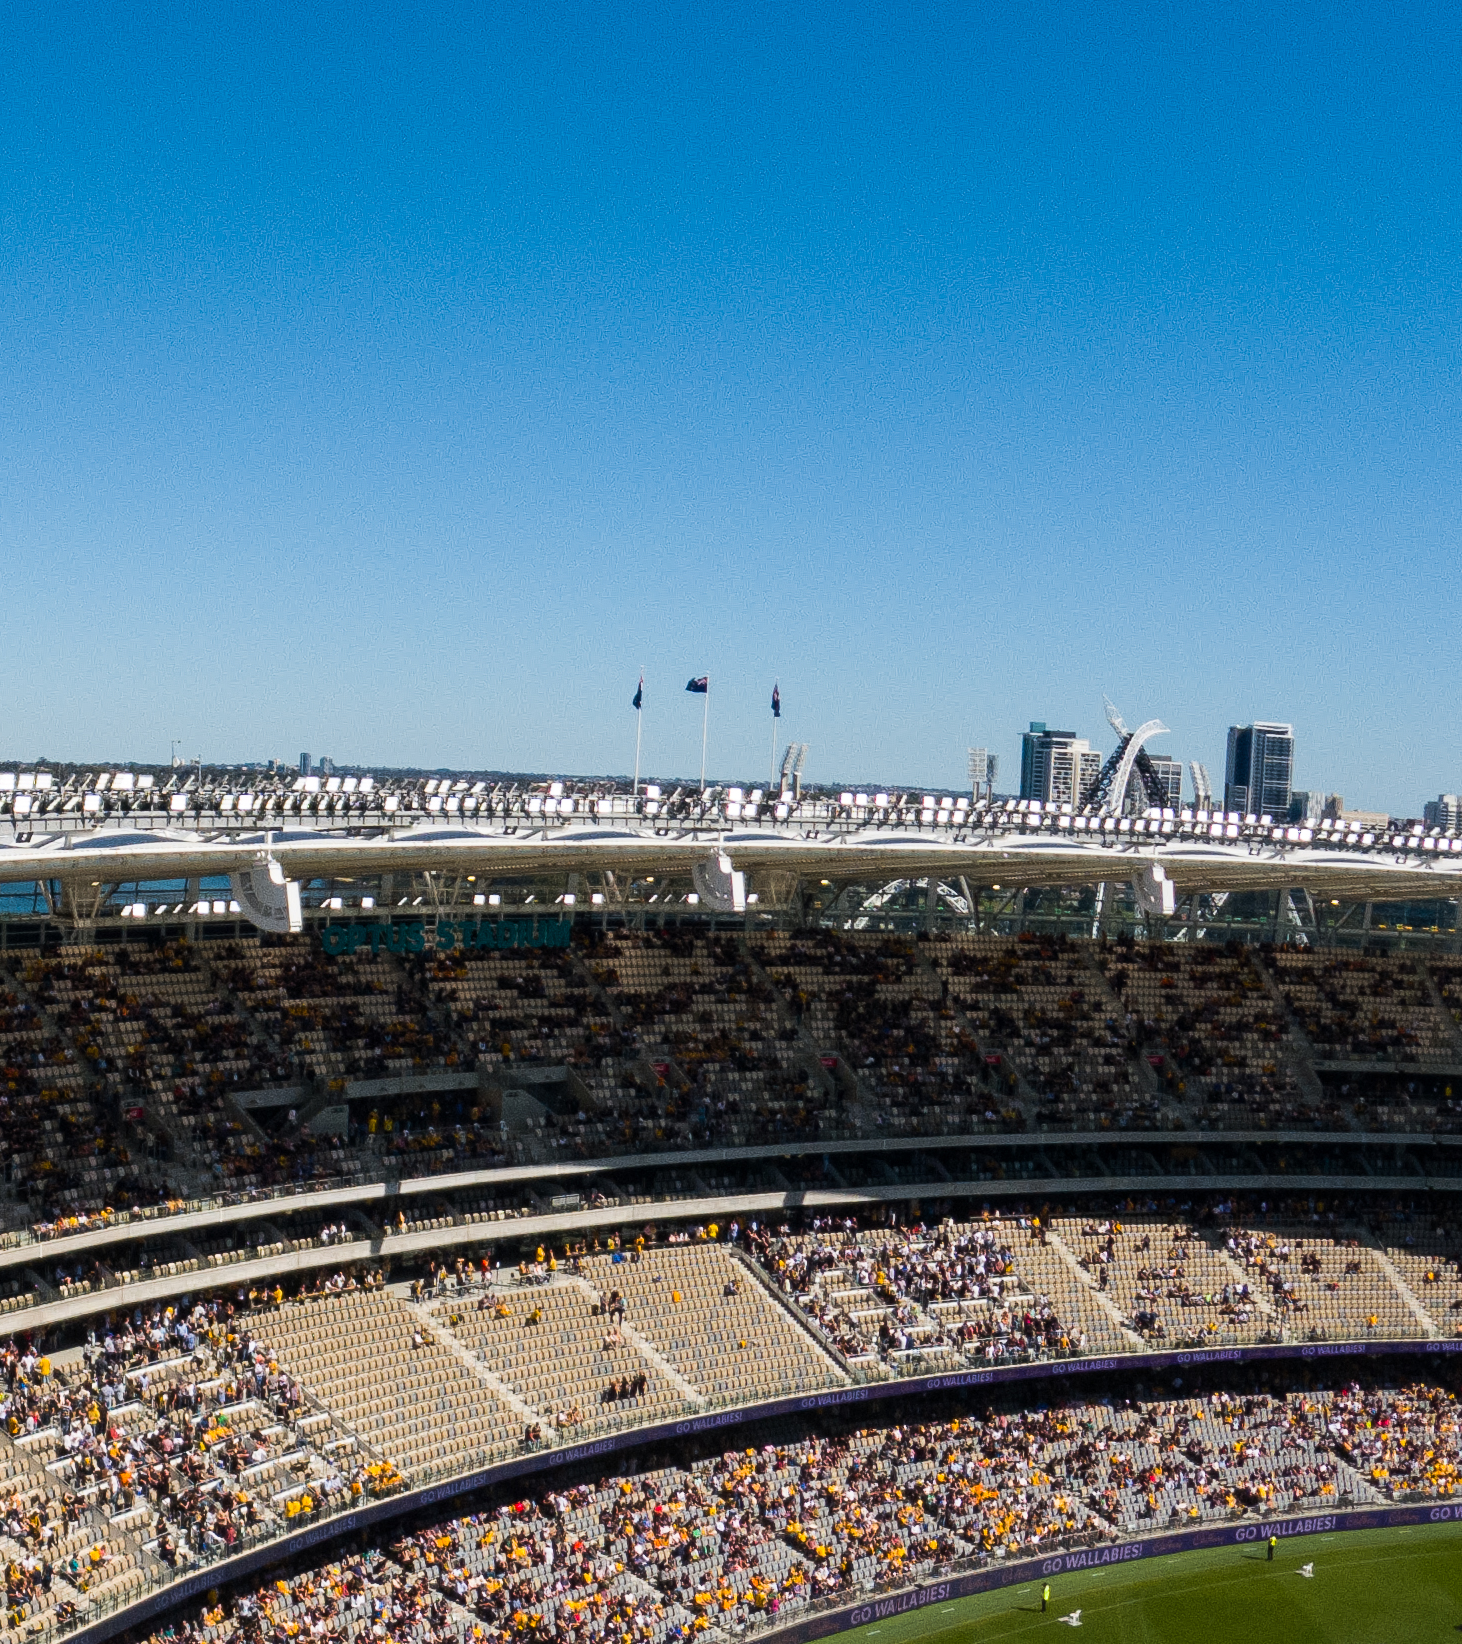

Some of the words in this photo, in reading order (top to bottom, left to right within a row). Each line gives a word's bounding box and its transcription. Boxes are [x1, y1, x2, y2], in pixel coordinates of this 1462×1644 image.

[1429, 1506, 1450, 1521] GO
[1236, 1525, 1257, 1541] GO
[1260, 1516, 1337, 1538] WALLABIES!
[1043, 1558, 1063, 1575] GO
[1065, 1543, 1143, 1570] WALLABIES!
[851, 1606, 872, 1624] GO
[875, 1584, 950, 1619] WALLABIES!
